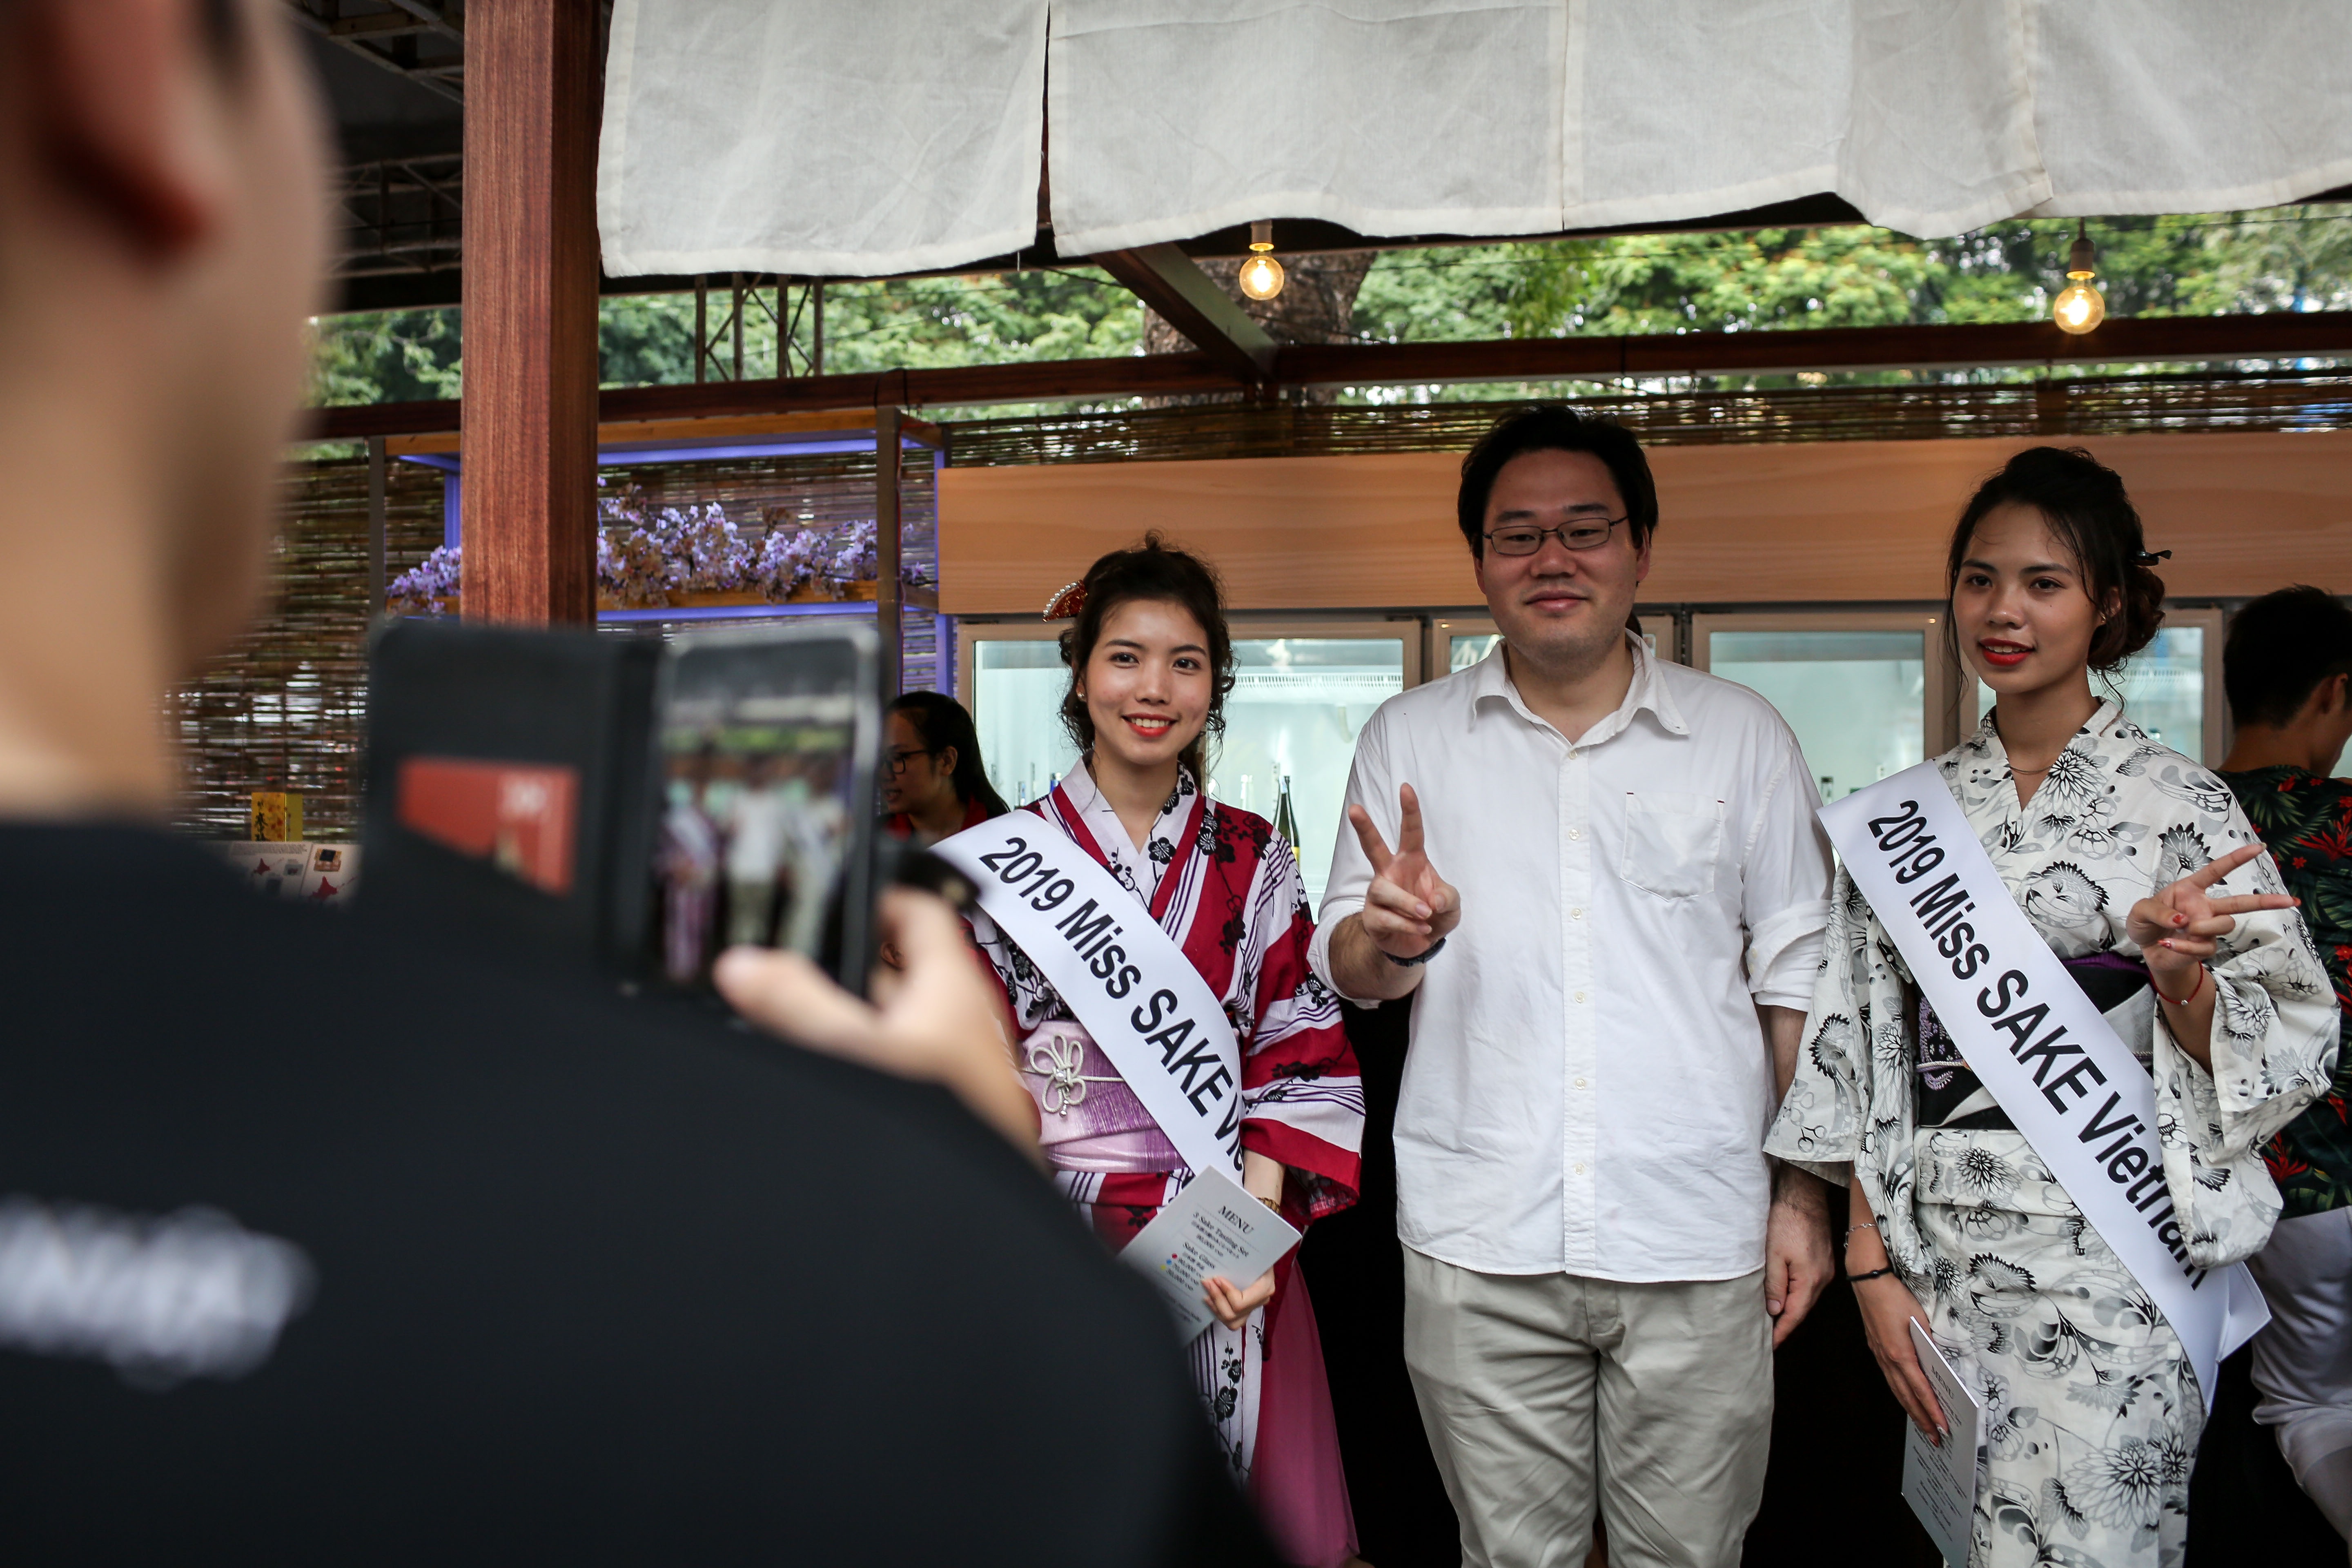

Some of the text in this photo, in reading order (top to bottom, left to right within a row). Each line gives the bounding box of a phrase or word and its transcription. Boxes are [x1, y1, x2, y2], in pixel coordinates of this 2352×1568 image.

[979, 837, 1075, 911] 2019
[1055, 898, 1142, 999] Miss
[1131, 989, 1234, 1117] SAKE
[1867, 800, 1945, 884] 2019
[1909, 873, 1990, 980] Miss
[1977, 970, 2107, 1115] SAKE
[1218, 1205, 1254, 1234] MENU
[1931, 1365, 1953, 1399] MENU
